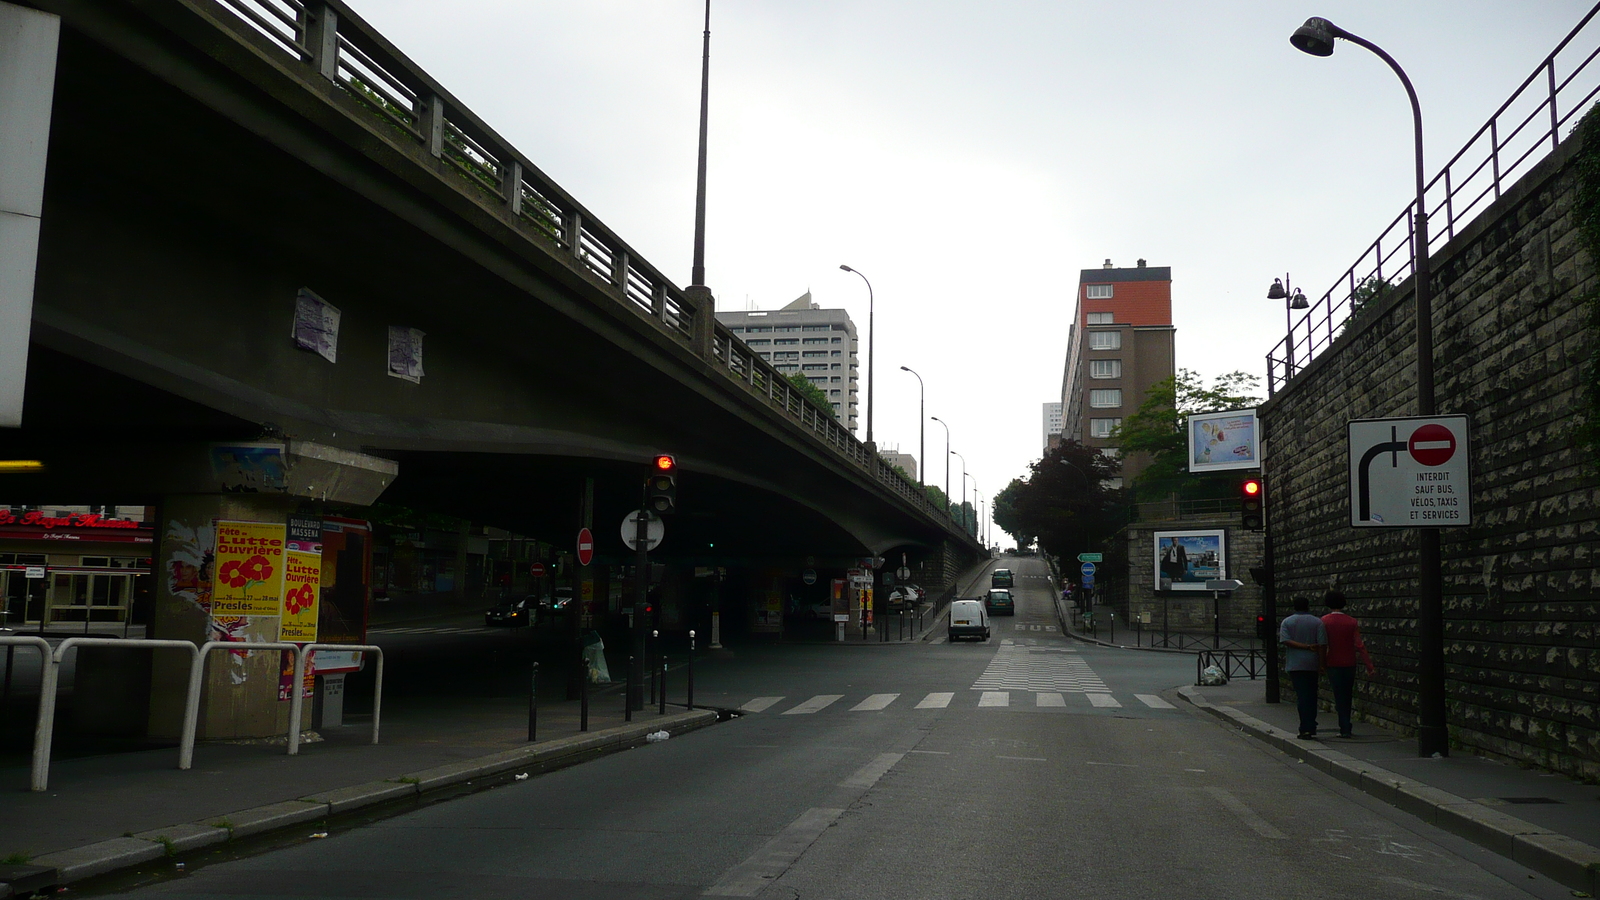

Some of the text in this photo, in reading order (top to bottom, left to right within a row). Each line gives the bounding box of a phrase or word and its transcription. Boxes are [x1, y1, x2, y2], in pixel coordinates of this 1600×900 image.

[1416, 472, 1450, 481] INTERDIT
[1415, 484, 1454, 494] SAUF BUS,
[1437, 497, 1458, 506] TAXIS
[1410, 510, 1459, 520] ET SERVICES
[290, 519, 321, 530] BOULEVARD
[219, 528, 240, 536] Fête
[291, 527, 319, 538] MASSENA
[219, 536, 282, 547] Lutte
[218, 545, 282, 556] Ouvrière
[286, 565, 320, 576] Lutte
[285, 573, 319, 585] Ouvrière
[214, 601, 253, 610] Presles
[281, 628, 303, 637] Presles
